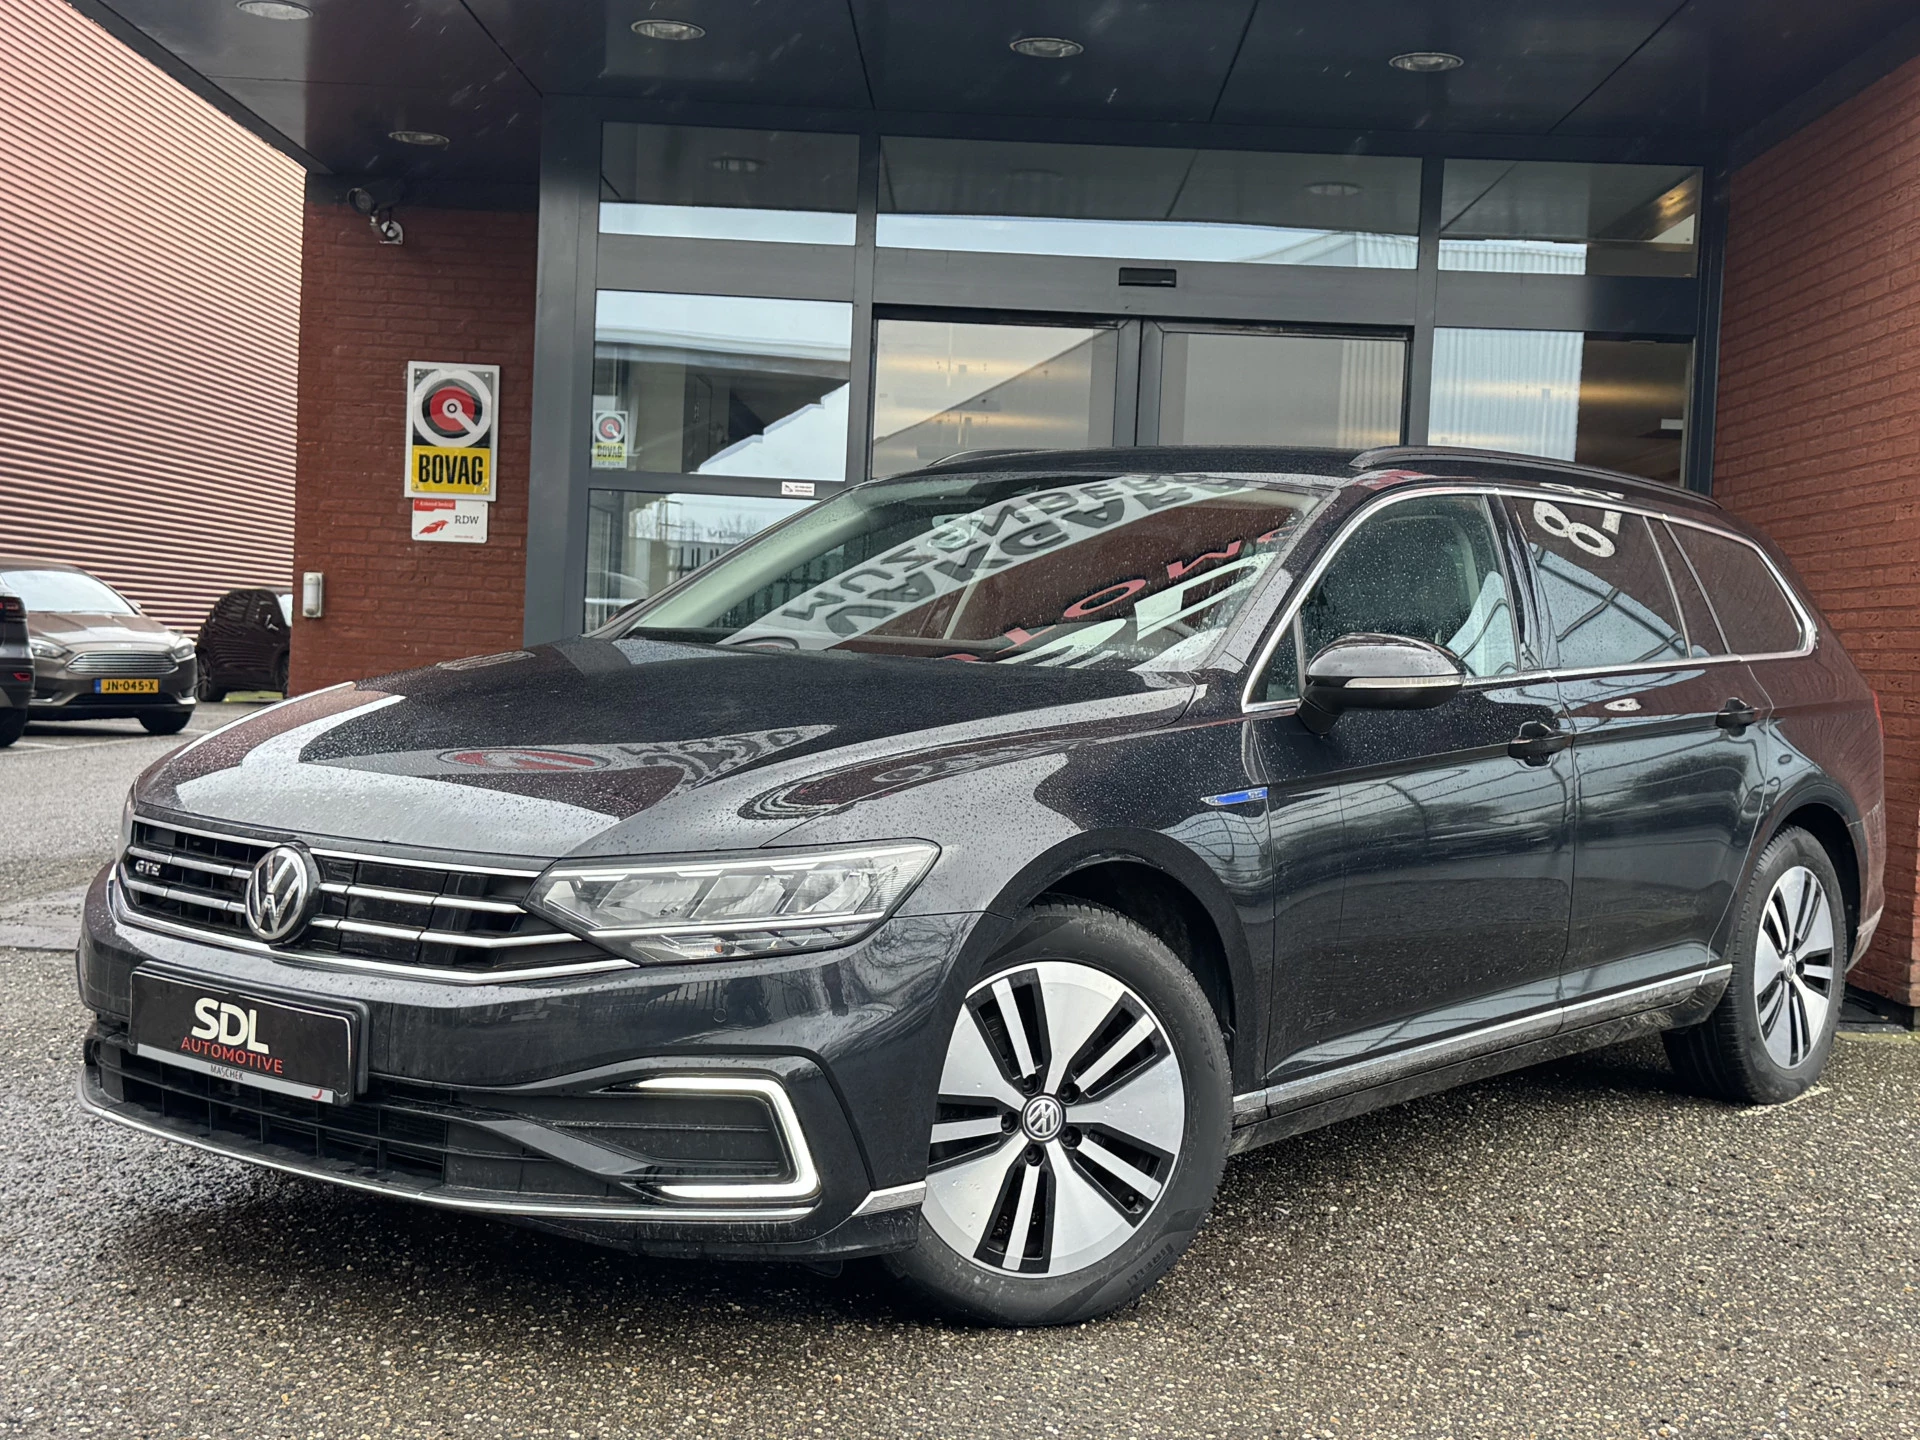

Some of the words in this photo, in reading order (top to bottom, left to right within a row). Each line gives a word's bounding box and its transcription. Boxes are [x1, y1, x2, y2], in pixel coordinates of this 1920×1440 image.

[418, 454, 484, 486] BOVAG
[454, 515, 479, 525] RDW
[135, 860, 161, 876] GTE
[191, 997, 269, 1055] SDL
[181, 1037, 283, 1074] AUTOMOTIVE
[210, 1064, 244, 1081] MASCHEK
[1126, 1242, 1175, 1287] PIRELLI
